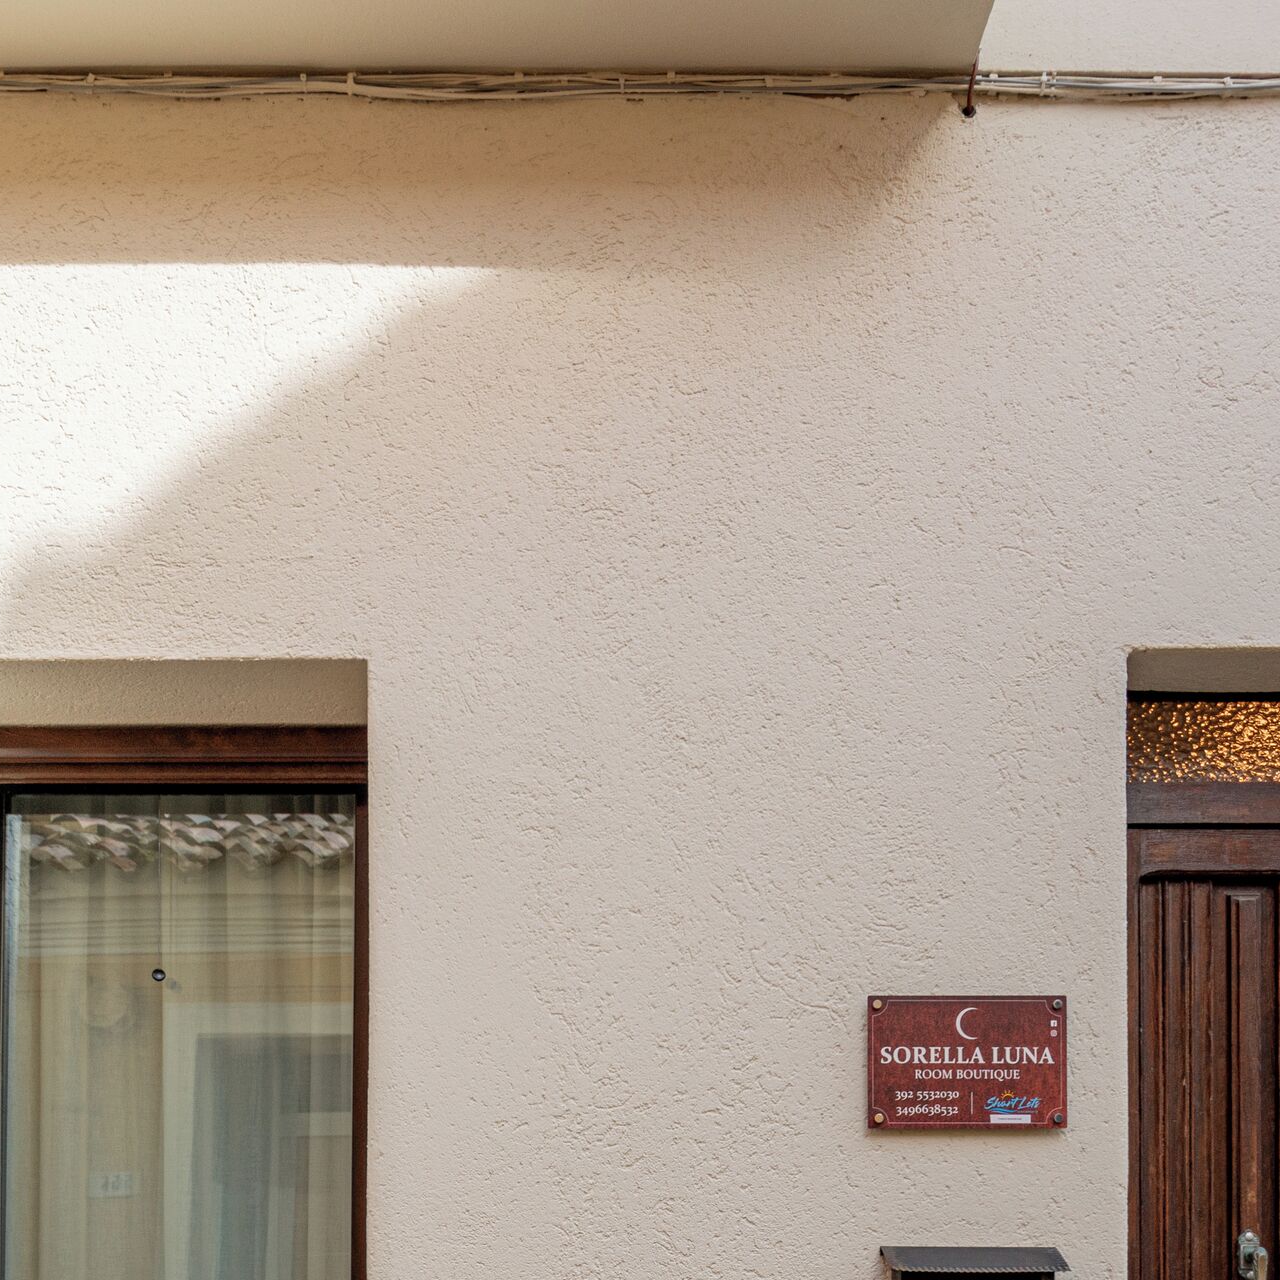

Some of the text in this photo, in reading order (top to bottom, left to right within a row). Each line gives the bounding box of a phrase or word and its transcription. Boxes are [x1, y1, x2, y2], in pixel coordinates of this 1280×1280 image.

[880, 1046, 1055, 1064] SORELLA LUNA
[915, 1069, 1020, 1082] ROOM BOUTIQUE
[895, 1091, 960, 1101] 392 5532030
[895, 1104, 959, 1116] 3496638532
